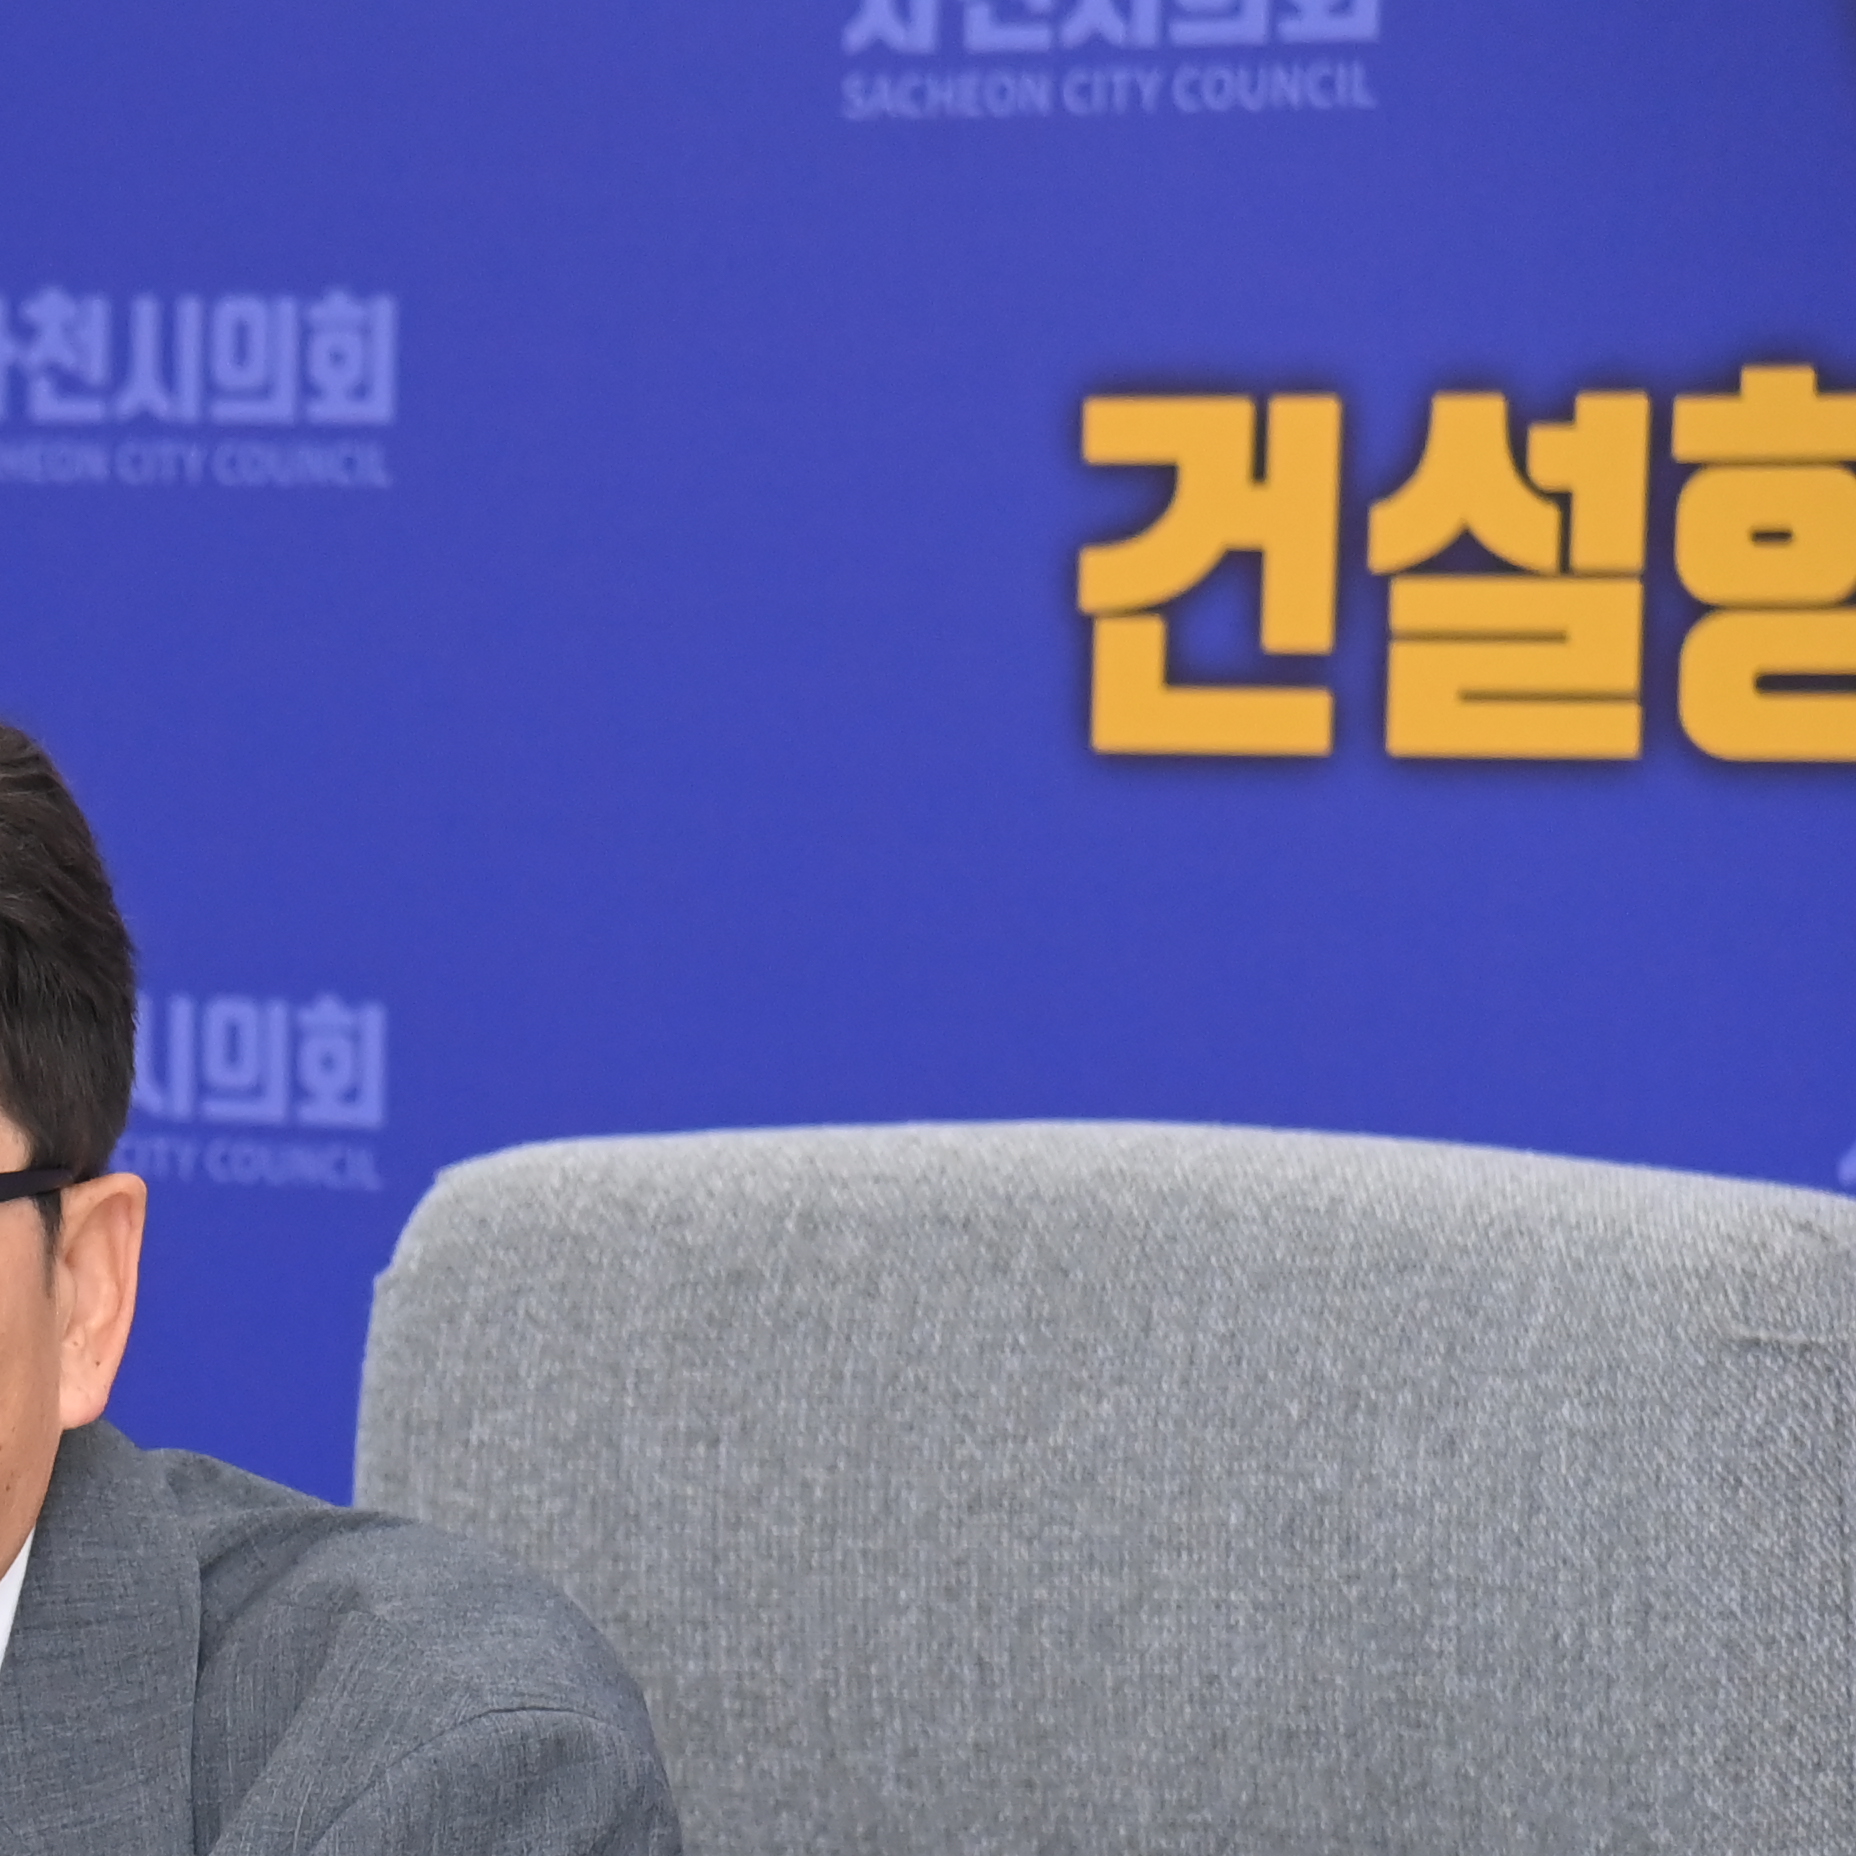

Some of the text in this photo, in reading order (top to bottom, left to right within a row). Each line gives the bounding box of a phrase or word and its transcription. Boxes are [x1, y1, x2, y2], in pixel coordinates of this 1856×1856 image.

[842, 60, 1375, 120] SACHEON CITY COUNCIL
